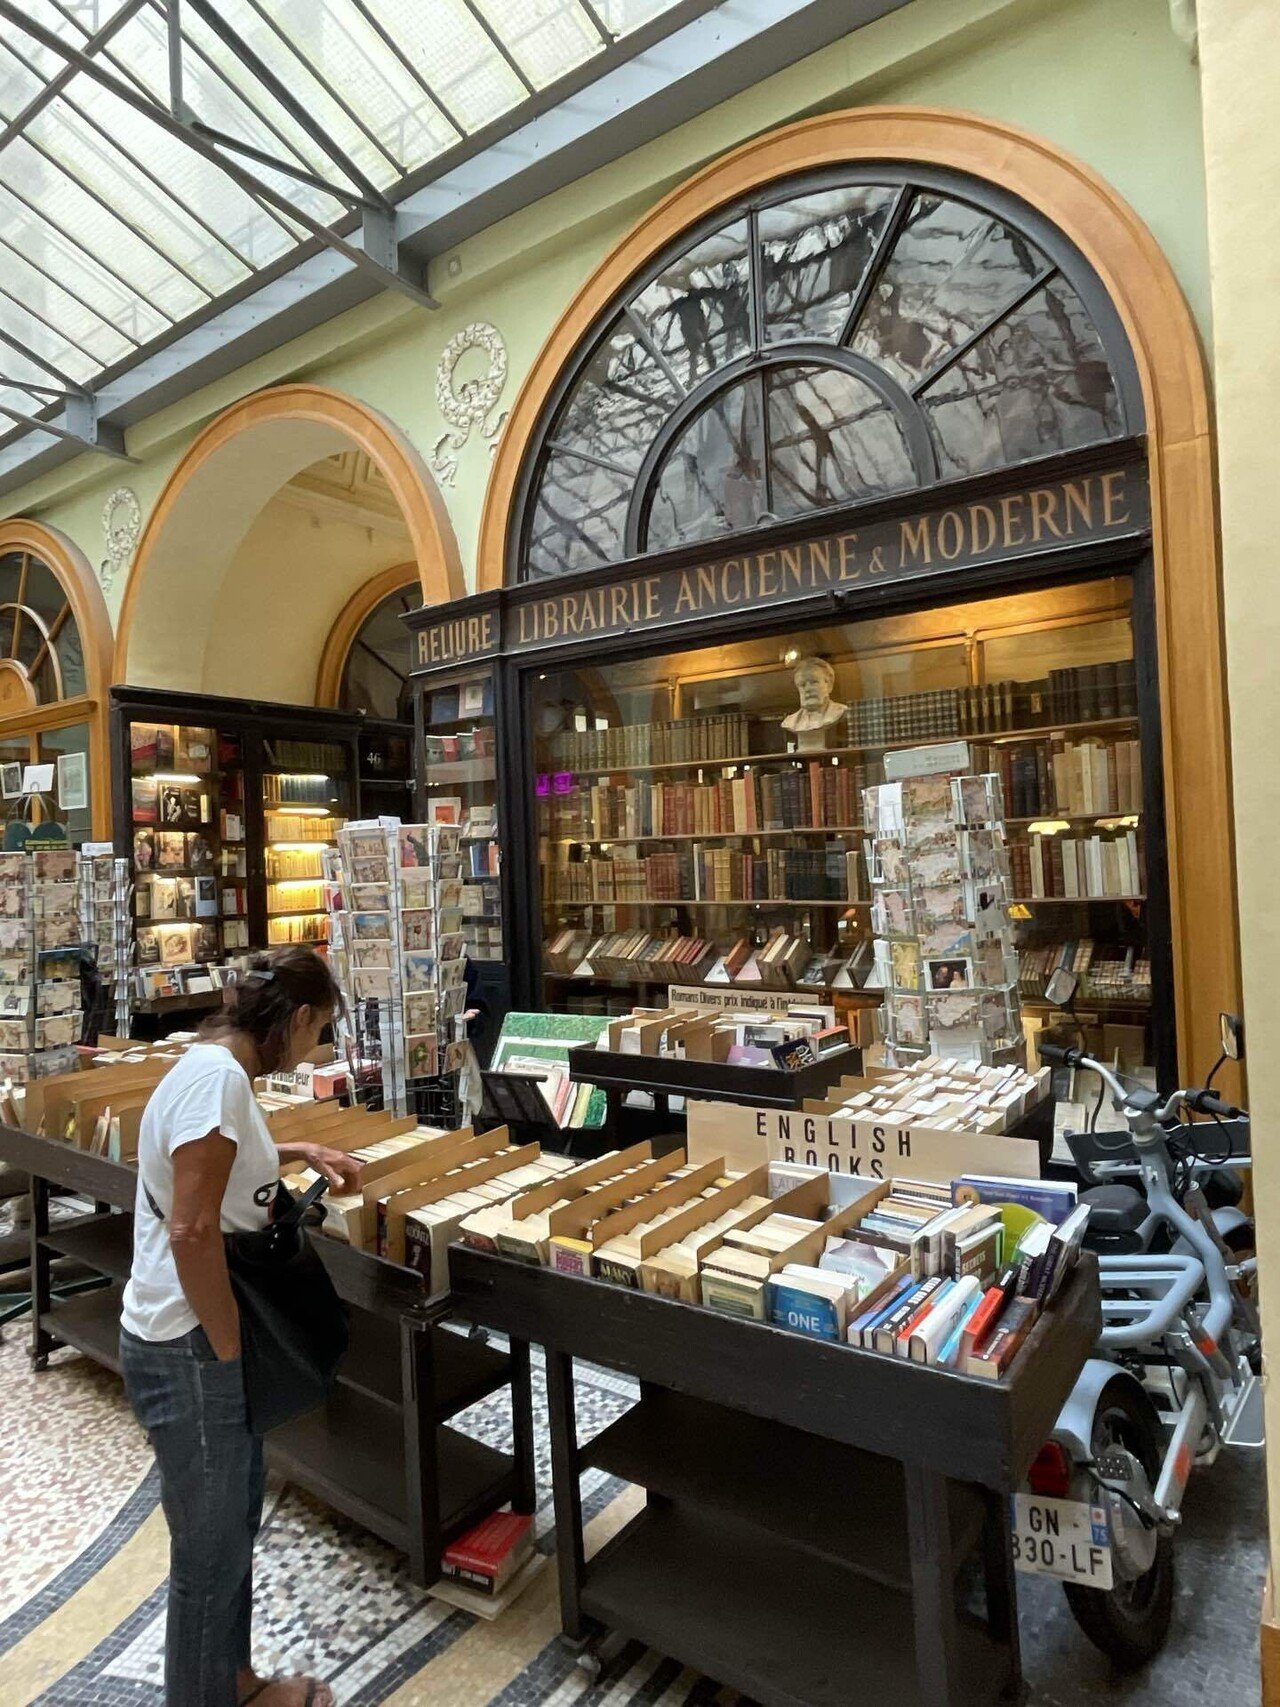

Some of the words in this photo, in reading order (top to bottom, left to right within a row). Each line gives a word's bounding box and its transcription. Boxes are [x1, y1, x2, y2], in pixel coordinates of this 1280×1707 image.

[518, 577, 662, 644] LIBRAIRIE
[674, 533, 861, 614] ANCIENNE
[869, 546, 886, 574] &
[899, 471, 1131, 568] MODERNE
[417, 613, 493, 665] RELIURE
[723, 994, 738, 1008] prix
[756, 1112, 911, 1157] ENGLISH
[787, 1311, 821, 1333] ONE
